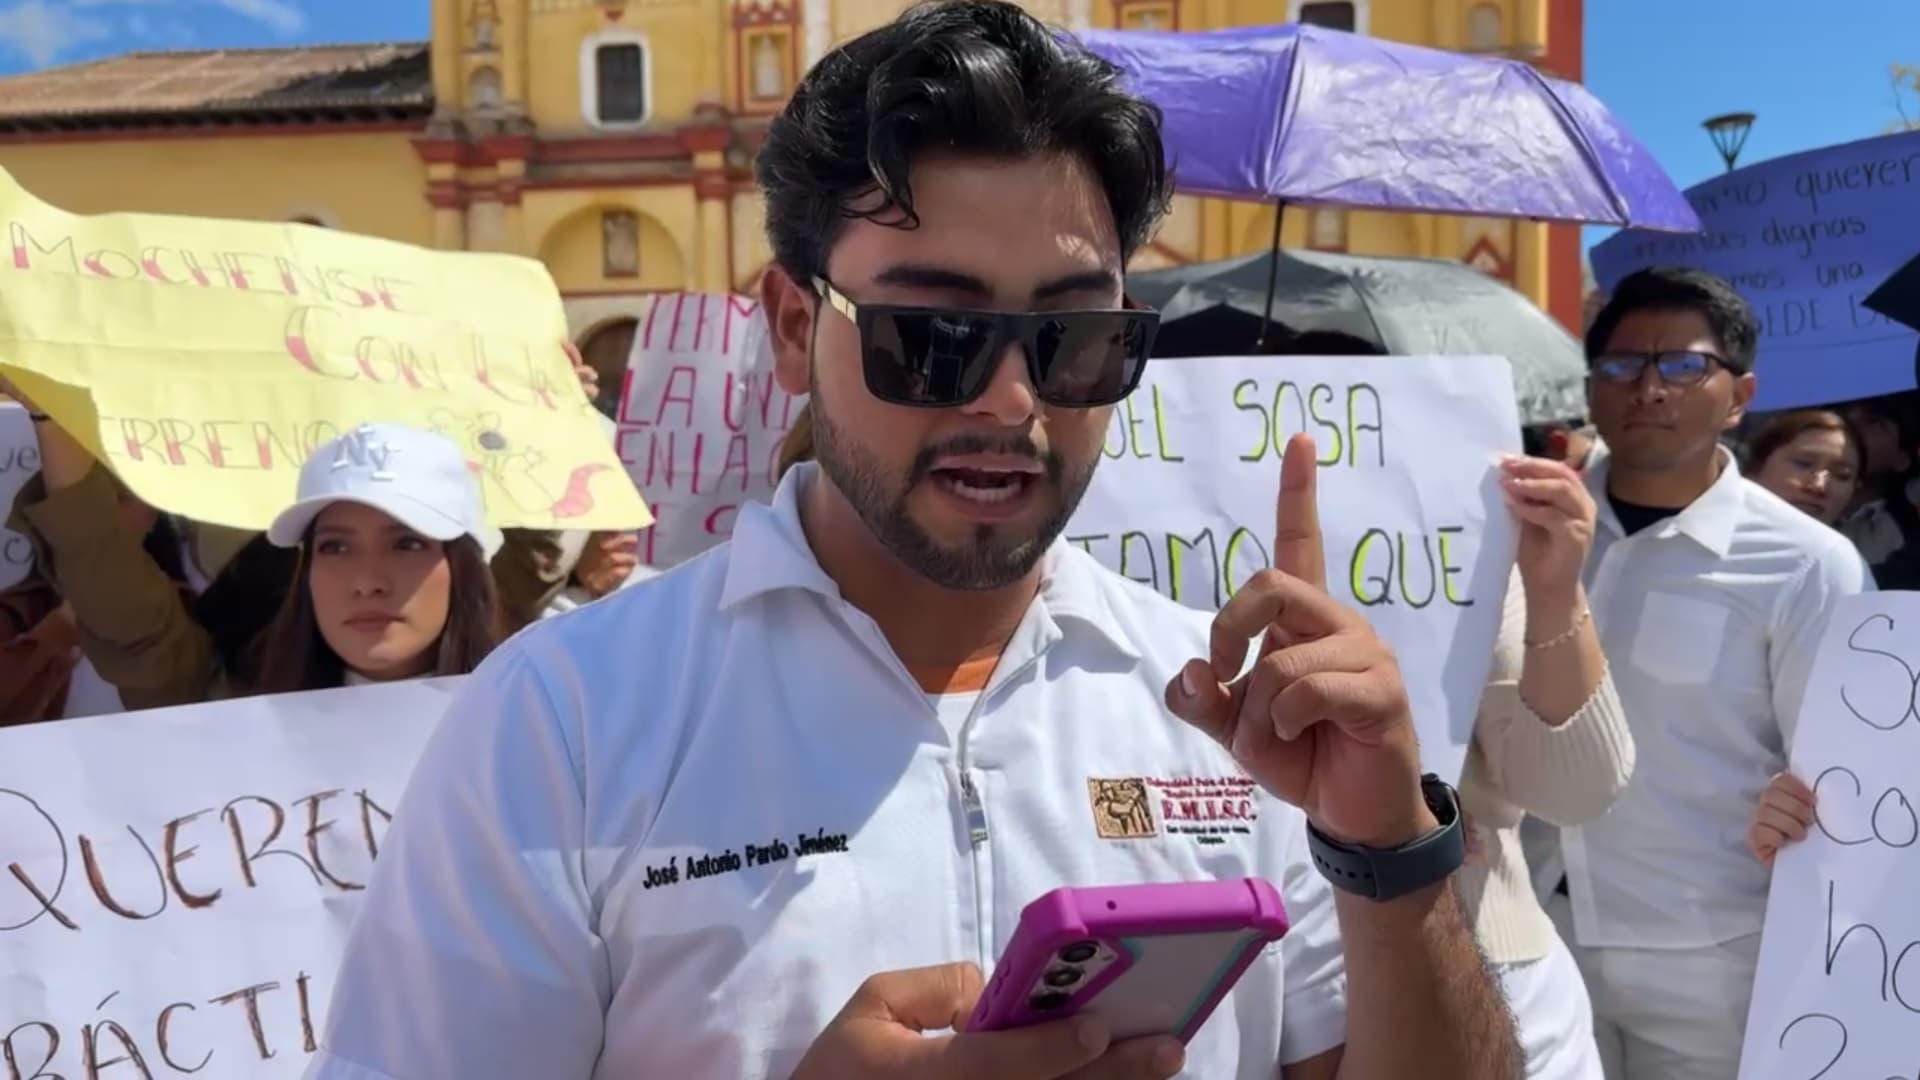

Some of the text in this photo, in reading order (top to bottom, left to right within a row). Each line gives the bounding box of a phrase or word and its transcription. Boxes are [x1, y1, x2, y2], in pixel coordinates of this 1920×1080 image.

[10, 221, 430, 316] MOCHENSE
[1761, 215, 1866, 258] dignas
[620, 366, 696, 428] LA
[1234, 379, 1385, 467] SOSA
[1350, 527, 1474, 609] QUE
[643, 827, 849, 889] José Antonio Pardo Jiménez
